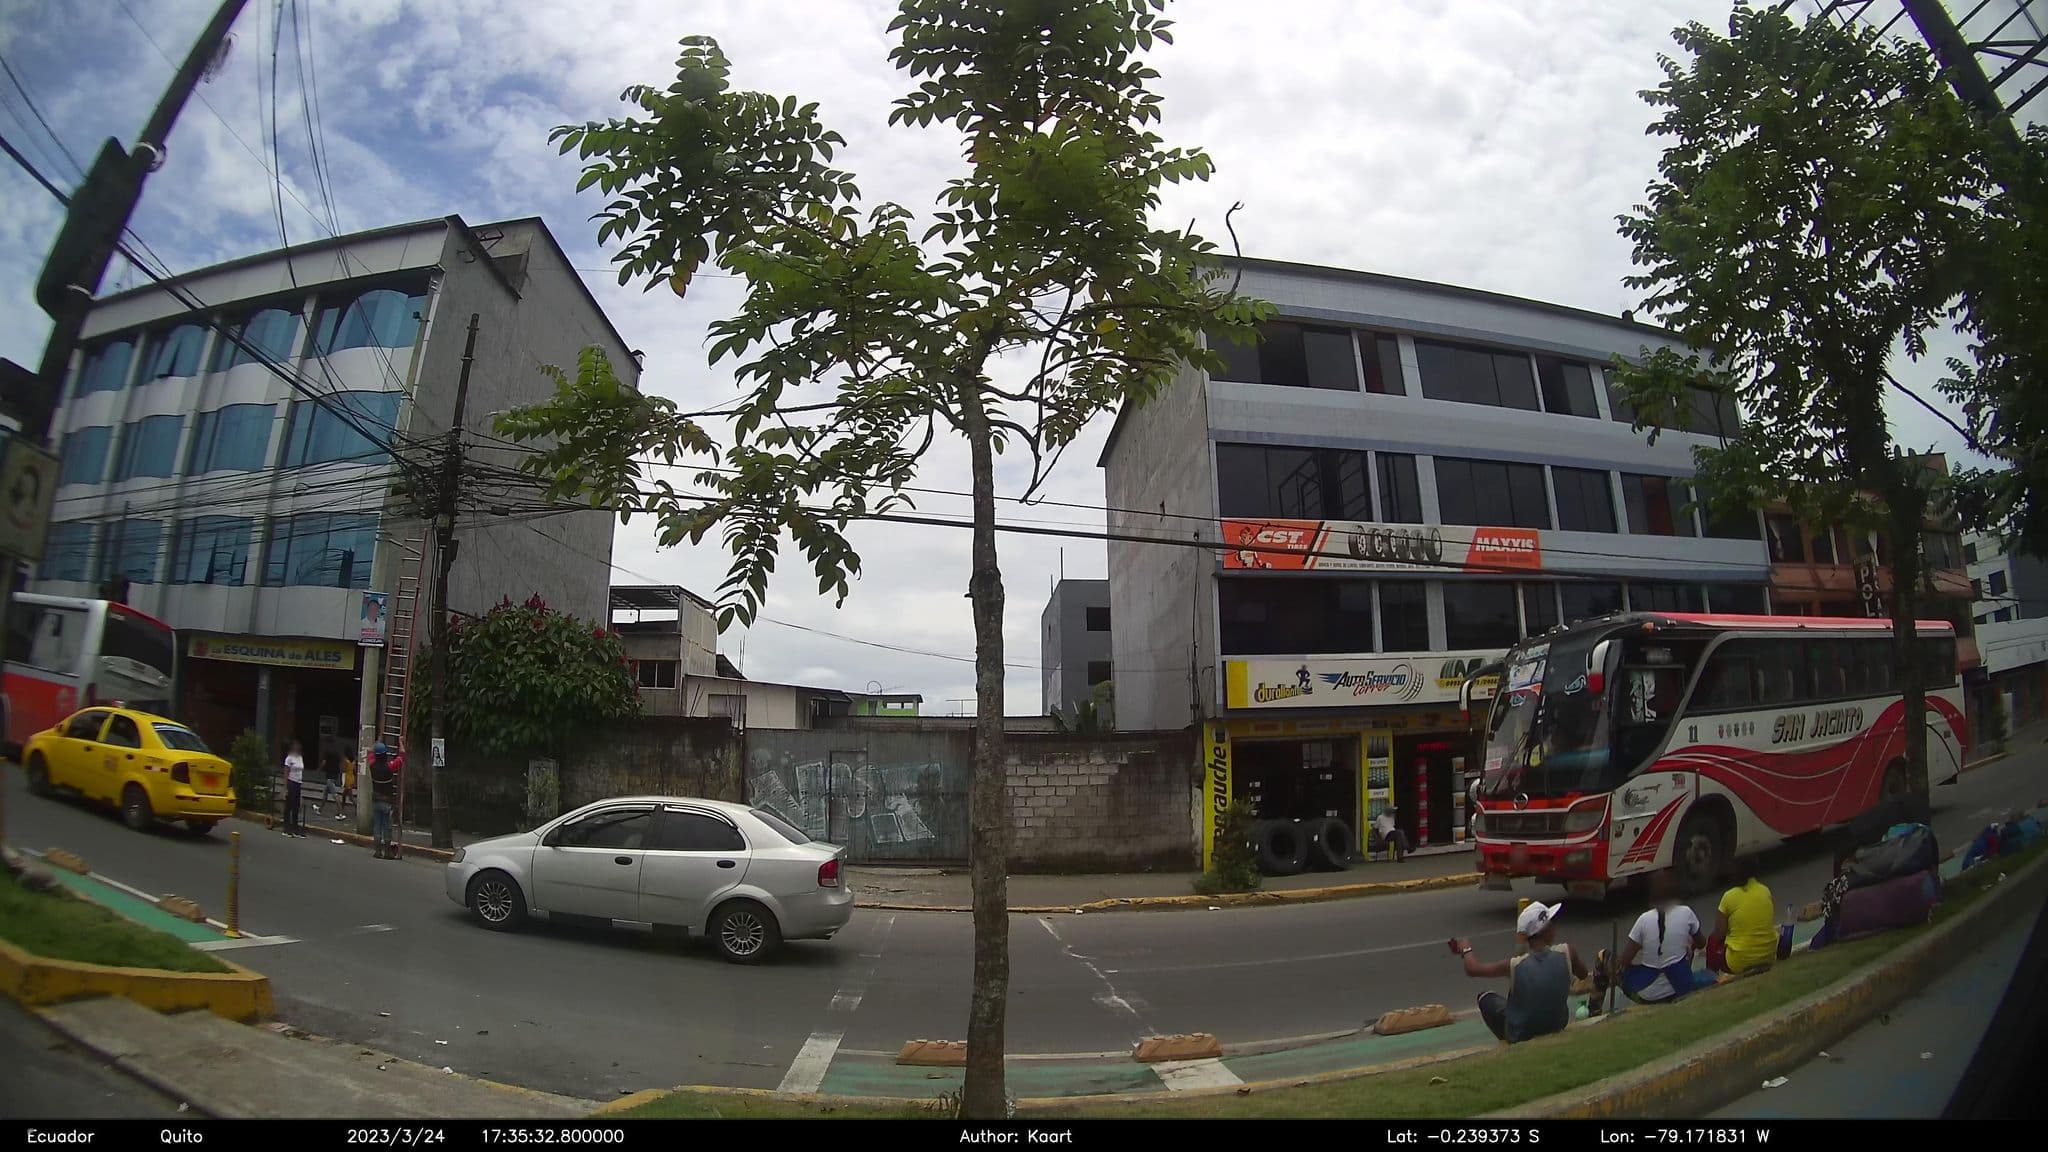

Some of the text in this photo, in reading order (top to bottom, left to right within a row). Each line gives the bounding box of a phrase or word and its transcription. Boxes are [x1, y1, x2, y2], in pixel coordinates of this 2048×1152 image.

[1257, 530, 1304, 543] CST
[1475, 537, 1535, 553] MAXXIS
[223, 643, 286, 660] ESQUINA
[304, 649, 343, 664] ALES
[1687, 724, 1700, 743] 11
[1771, 706, 1864, 745] SAN JACINTO
